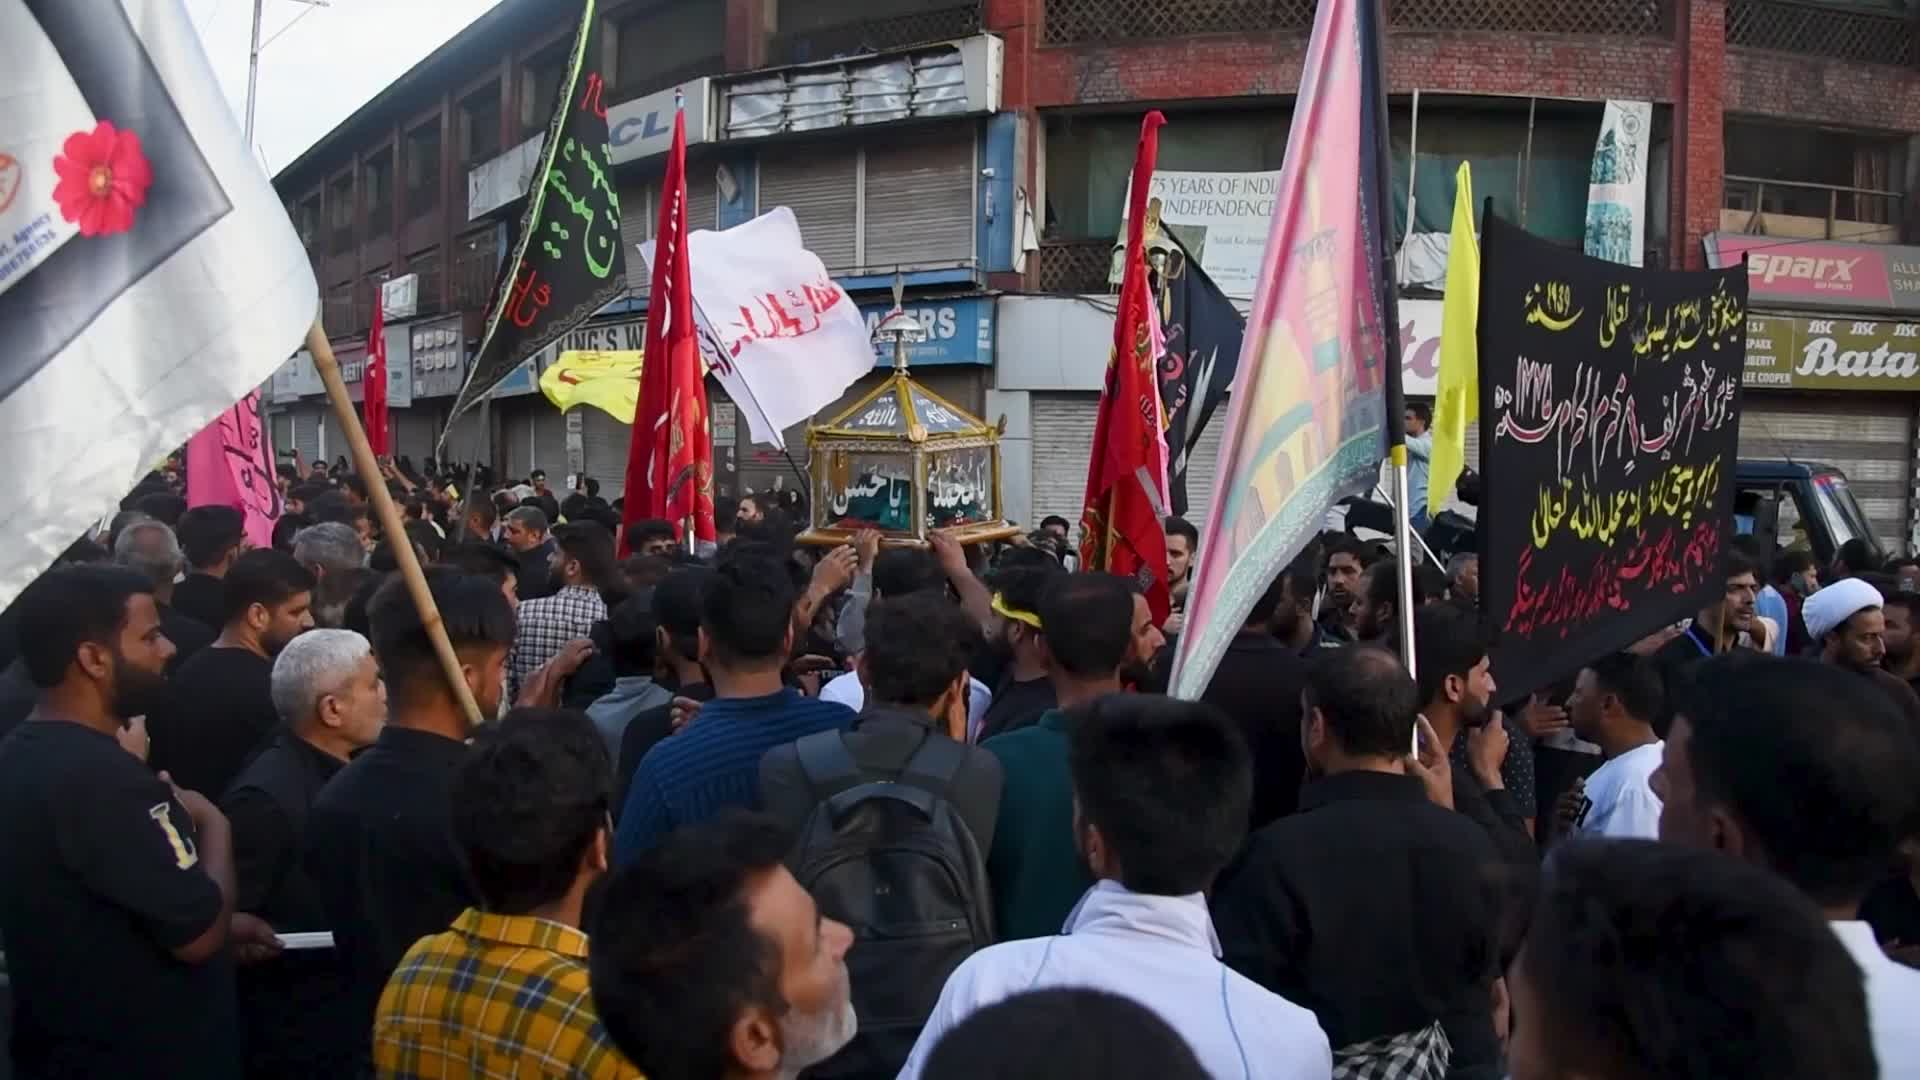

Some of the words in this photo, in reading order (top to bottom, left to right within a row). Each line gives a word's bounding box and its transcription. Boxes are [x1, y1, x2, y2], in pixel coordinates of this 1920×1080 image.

[1152, 178, 1166, 193] 75
[1170, 178, 1214, 194] YEARS
[1219, 178, 1239, 194] OF
[1164, 200, 1274, 217] INDEPENDENCE
[1748, 254, 1863, 284] sparx
[1796, 337, 1920, 378] Bata
